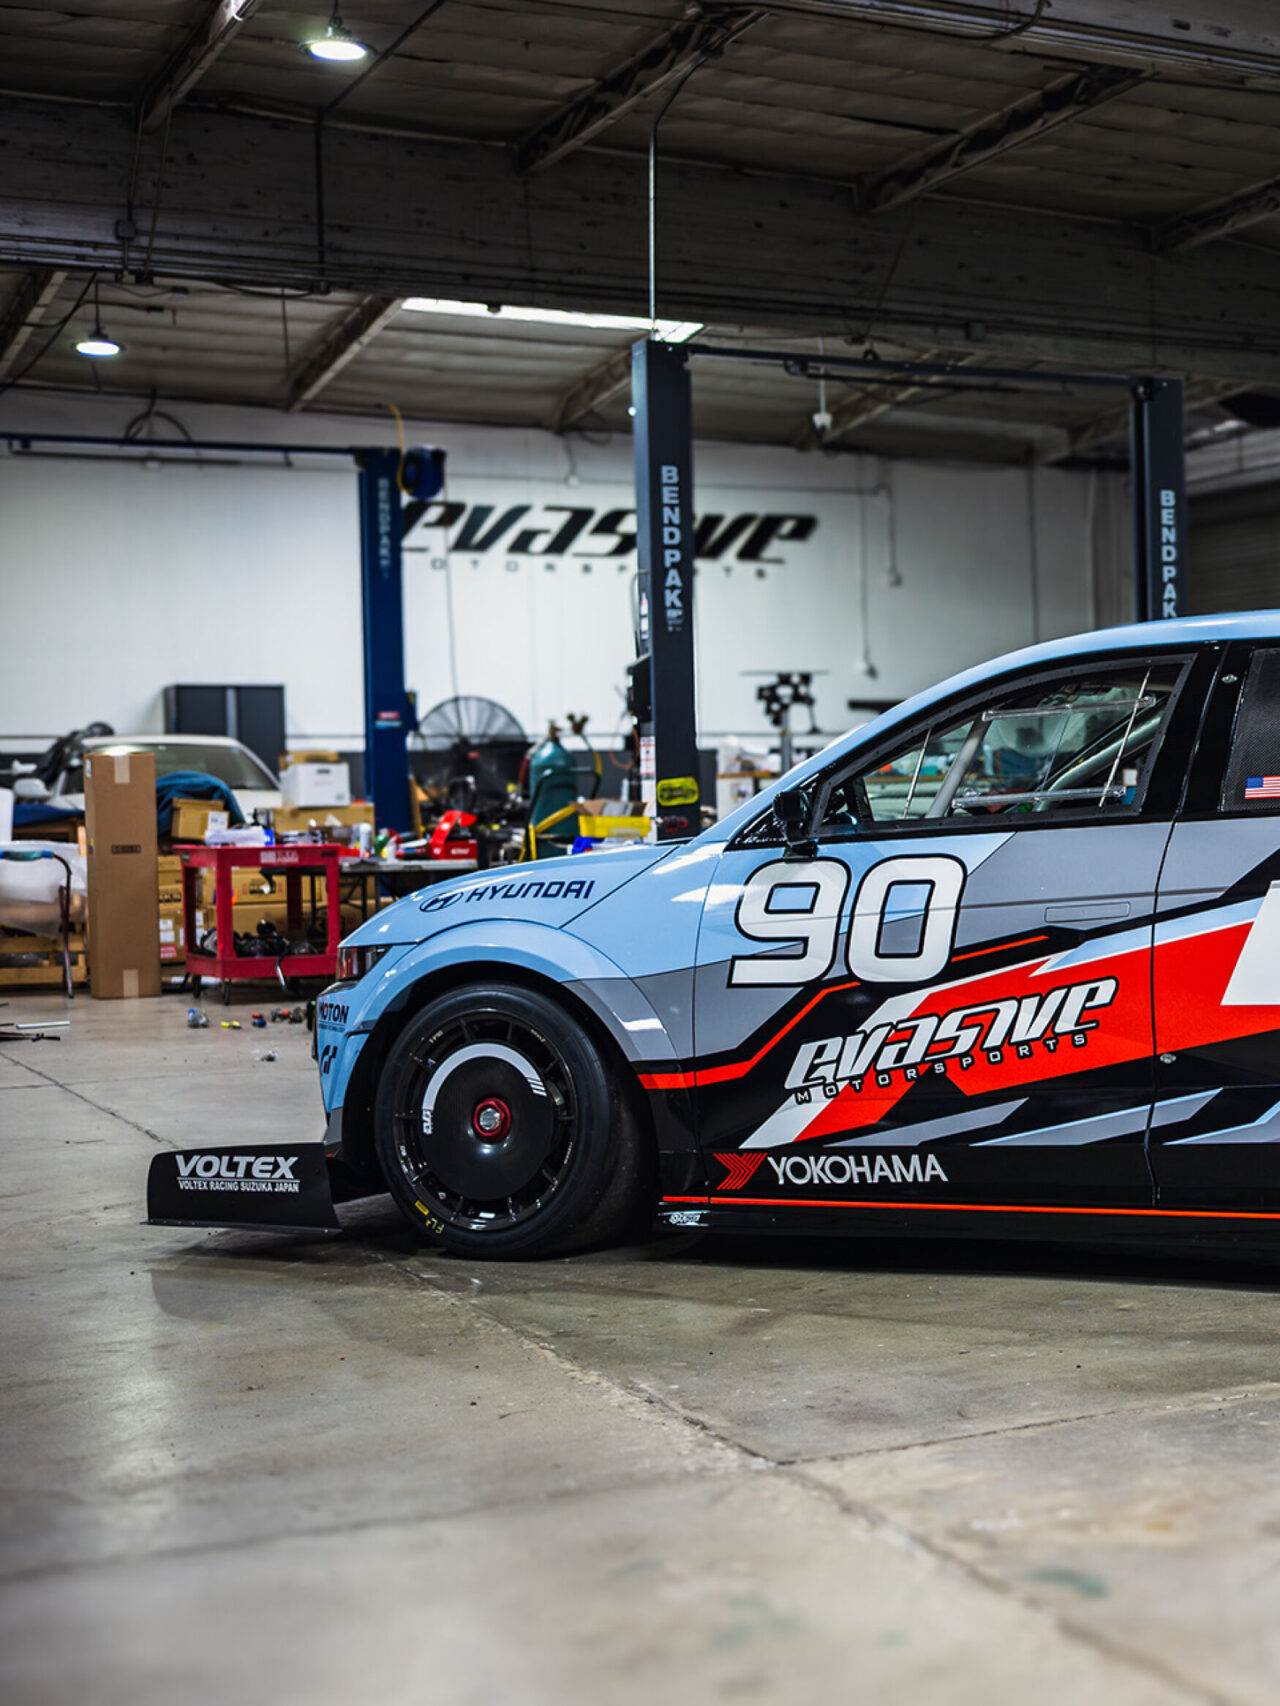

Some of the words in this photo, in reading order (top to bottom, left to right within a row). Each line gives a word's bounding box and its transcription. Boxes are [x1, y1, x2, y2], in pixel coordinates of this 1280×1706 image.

[661, 465, 682, 607] BENDPAK
[1160, 489, 1177, 618] BENDPAK
[466, 880, 595, 903] HYUNDAI
[727, 853, 968, 988] 90
[797, 1033, 1085, 1102] MOTORSPORTS
[175, 1154, 298, 1179] VOLTEX
[178, 1180, 208, 1190] VOLTEX
[210, 1180, 239, 1191] RACING
[240, 1181, 273, 1192] SUZUKA
[275, 1182, 299, 1192] JAPAN
[767, 1154, 949, 1185] YOKOHAMA
